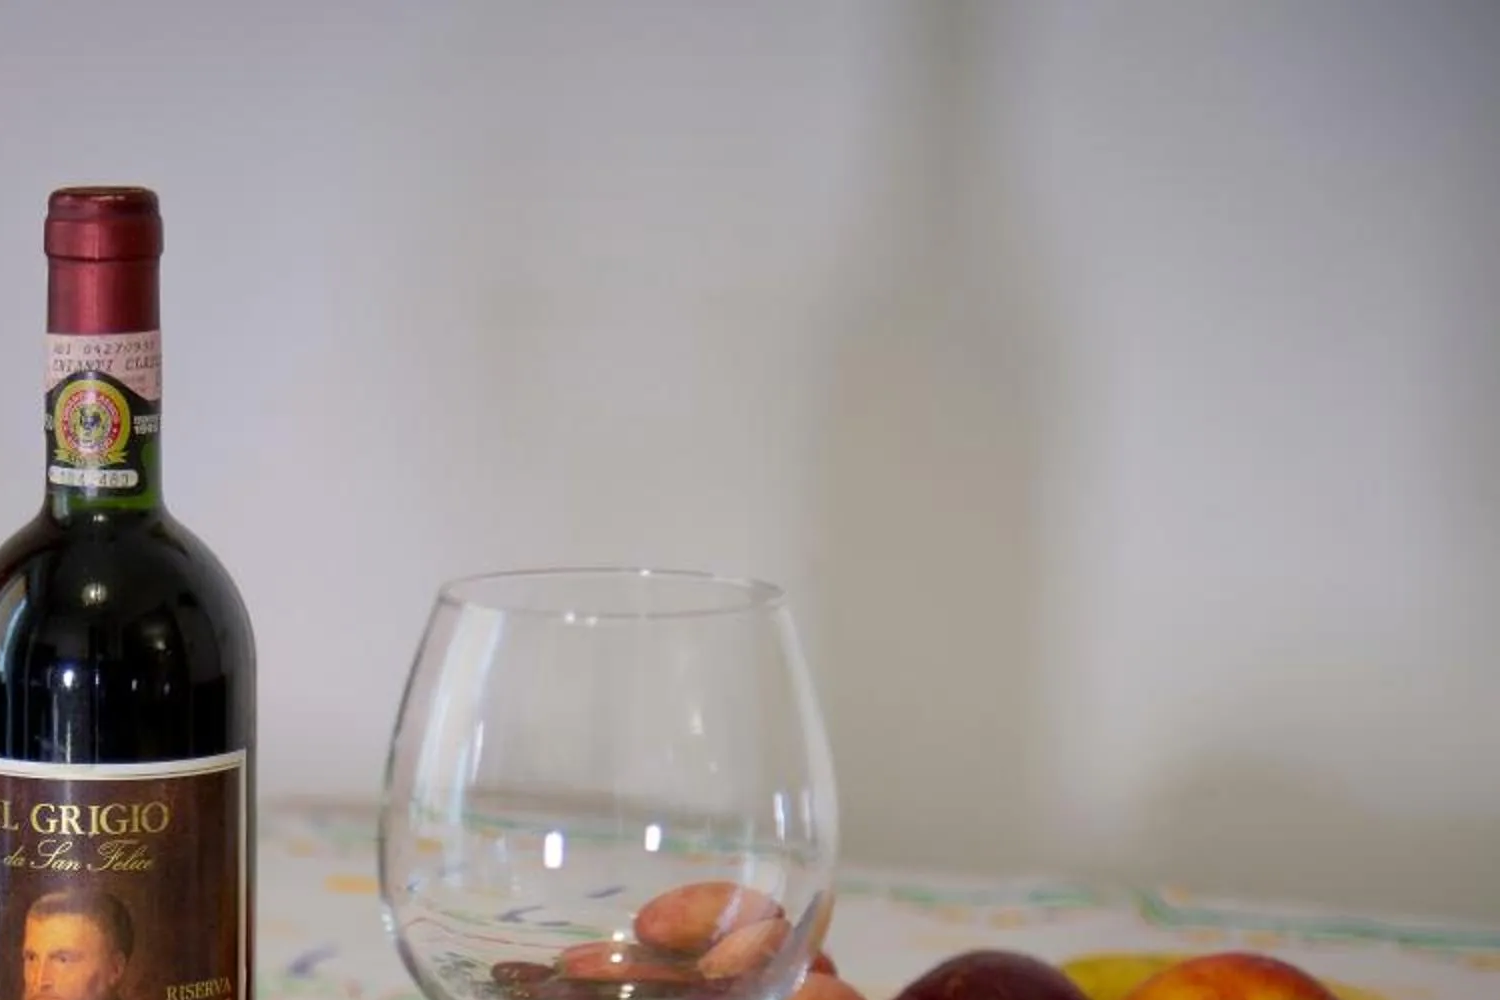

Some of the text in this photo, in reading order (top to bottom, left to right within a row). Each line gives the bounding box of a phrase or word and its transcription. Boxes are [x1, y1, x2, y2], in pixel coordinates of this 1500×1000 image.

[30, 802, 170, 837] GRIGIO
[3, 838, 154, 872] da San Felice
